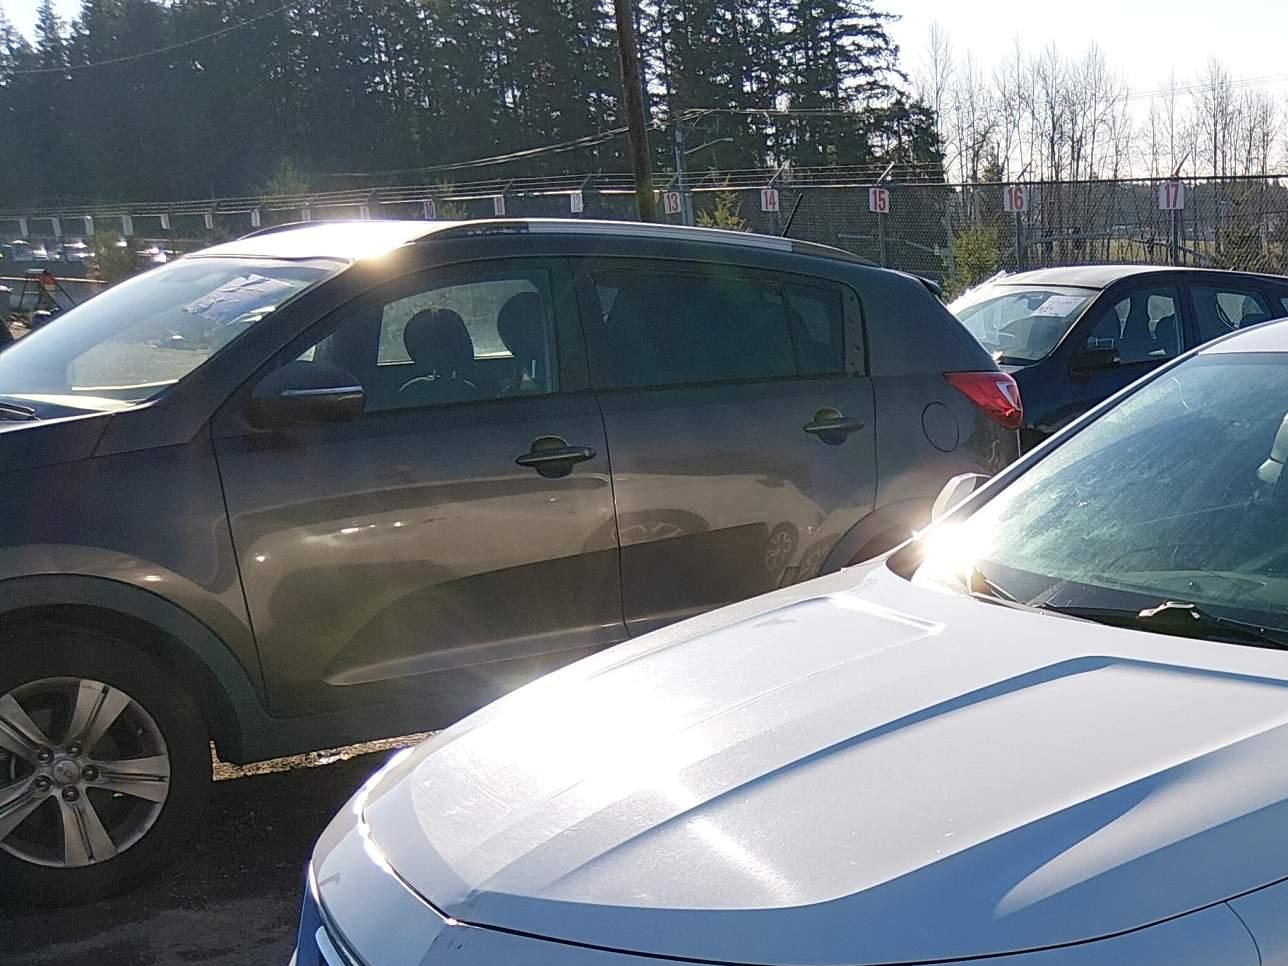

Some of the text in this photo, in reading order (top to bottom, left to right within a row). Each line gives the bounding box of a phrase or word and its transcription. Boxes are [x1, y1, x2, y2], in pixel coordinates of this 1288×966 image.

[666, 193, 678, 211] 13
[764, 190, 776, 210] 14
[873, 190, 886, 211] 15
[1008, 187, 1024, 210] 16
[1164, 183, 1179, 208] 17
